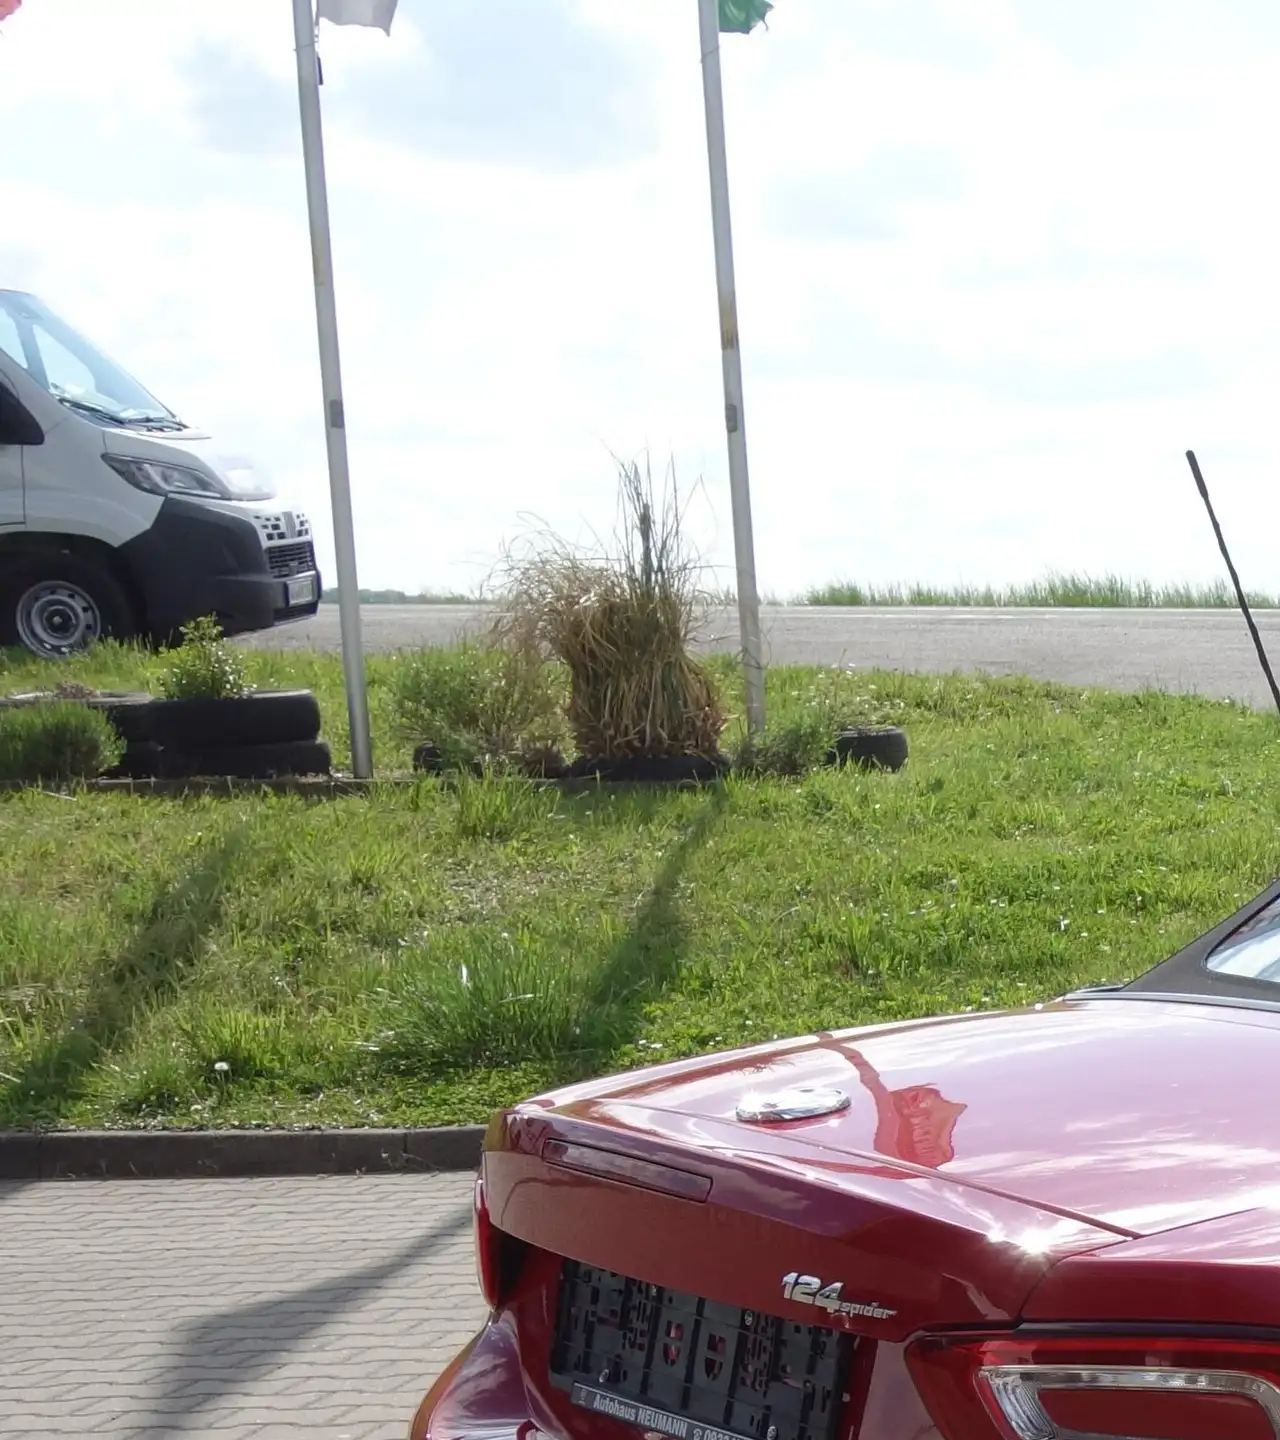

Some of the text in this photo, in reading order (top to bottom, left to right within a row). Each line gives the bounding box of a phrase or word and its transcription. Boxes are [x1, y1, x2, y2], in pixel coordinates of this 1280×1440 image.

[782, 1271, 898, 1319] 124 spider
[593, 1395, 636, 1421] Autohaus
[637, 1407, 688, 1438] NEUMANN
